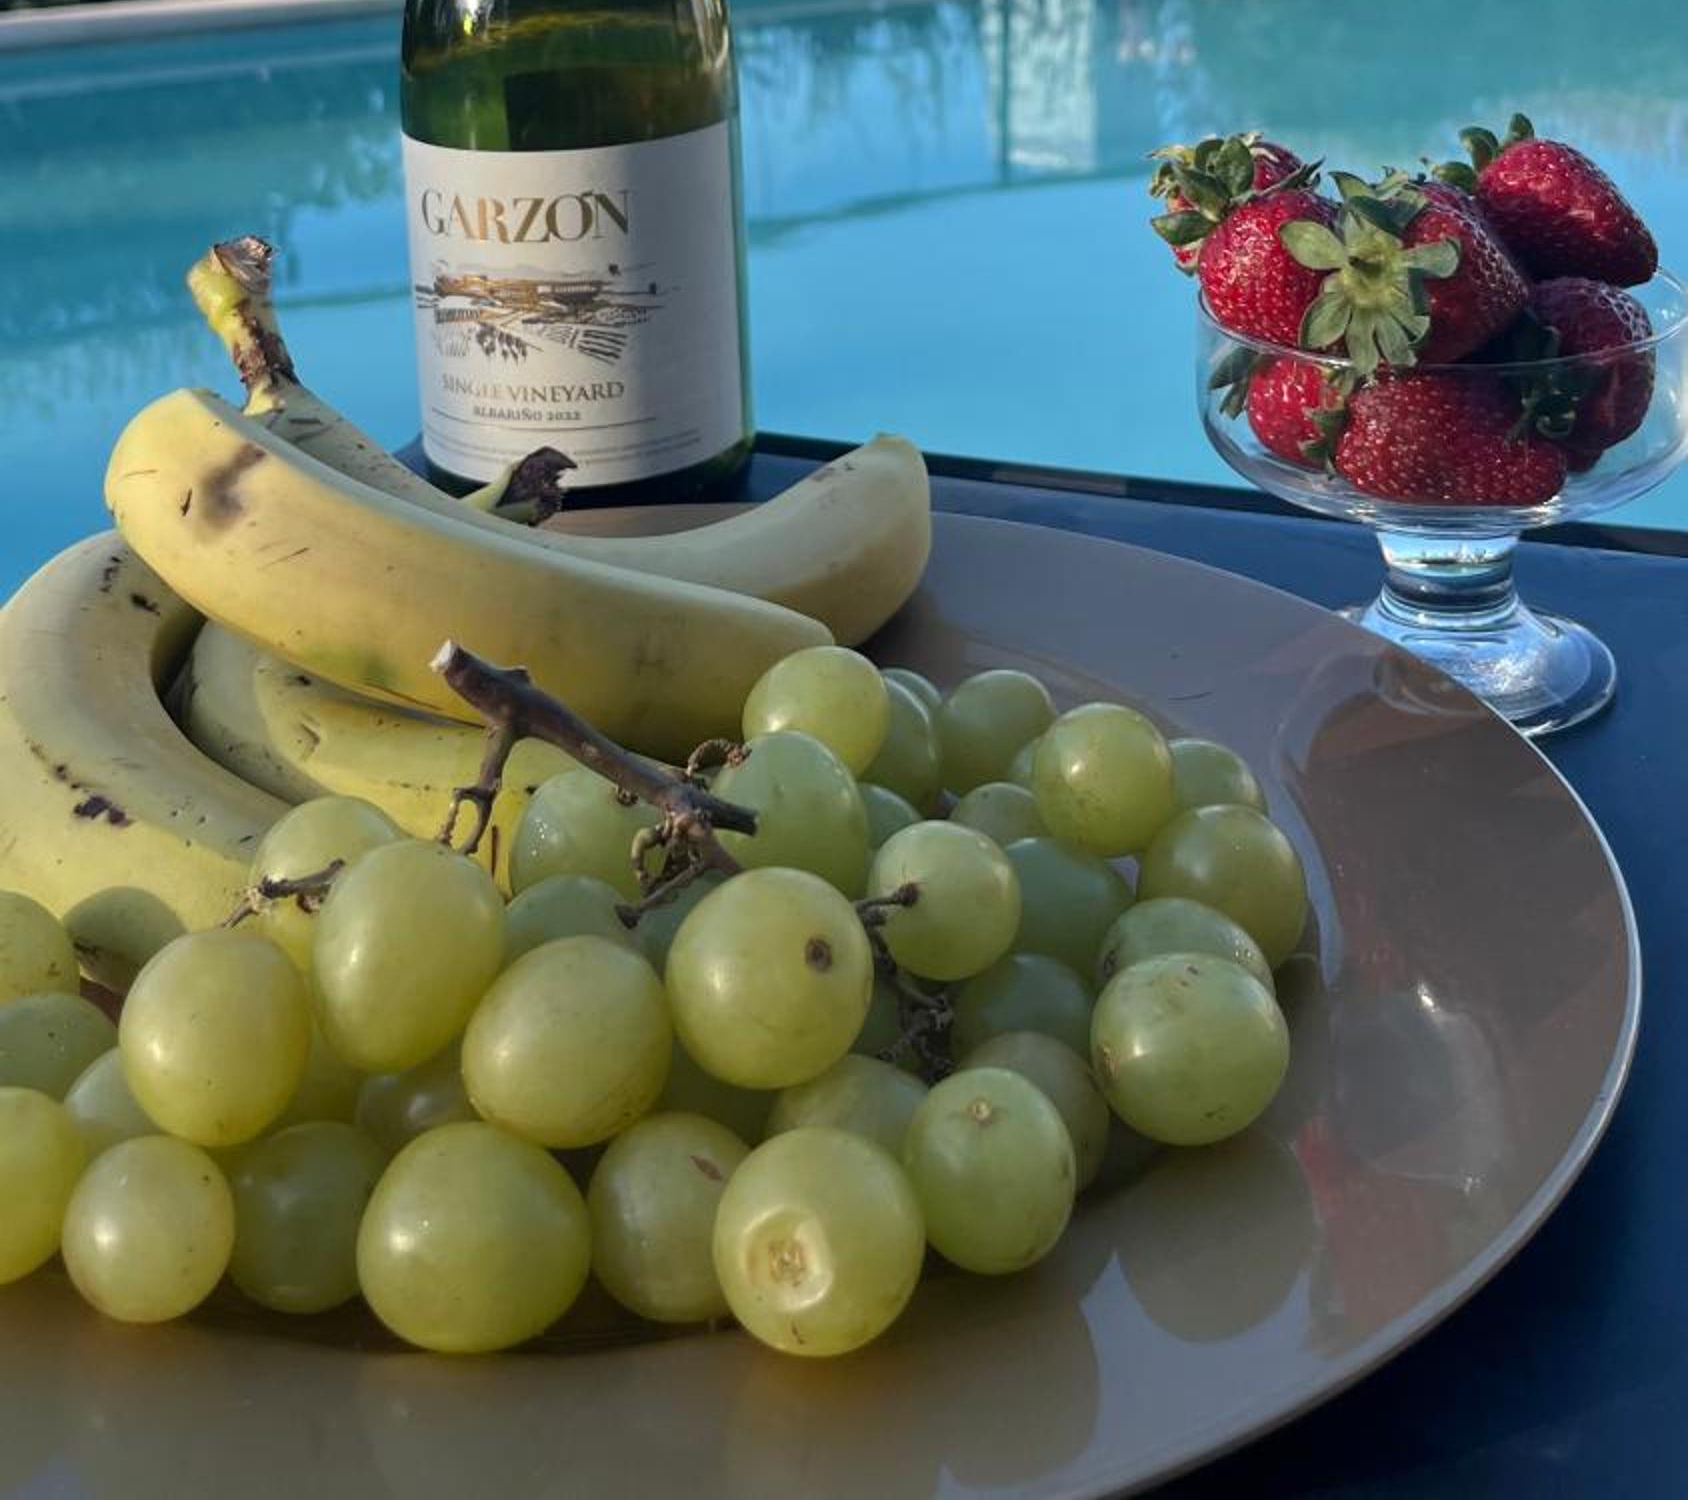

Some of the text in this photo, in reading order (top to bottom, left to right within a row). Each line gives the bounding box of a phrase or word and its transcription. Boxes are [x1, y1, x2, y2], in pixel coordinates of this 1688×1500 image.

[421, 187, 630, 244] GARZÓN
[442, 373, 625, 403] SINGLE VINEYARD
